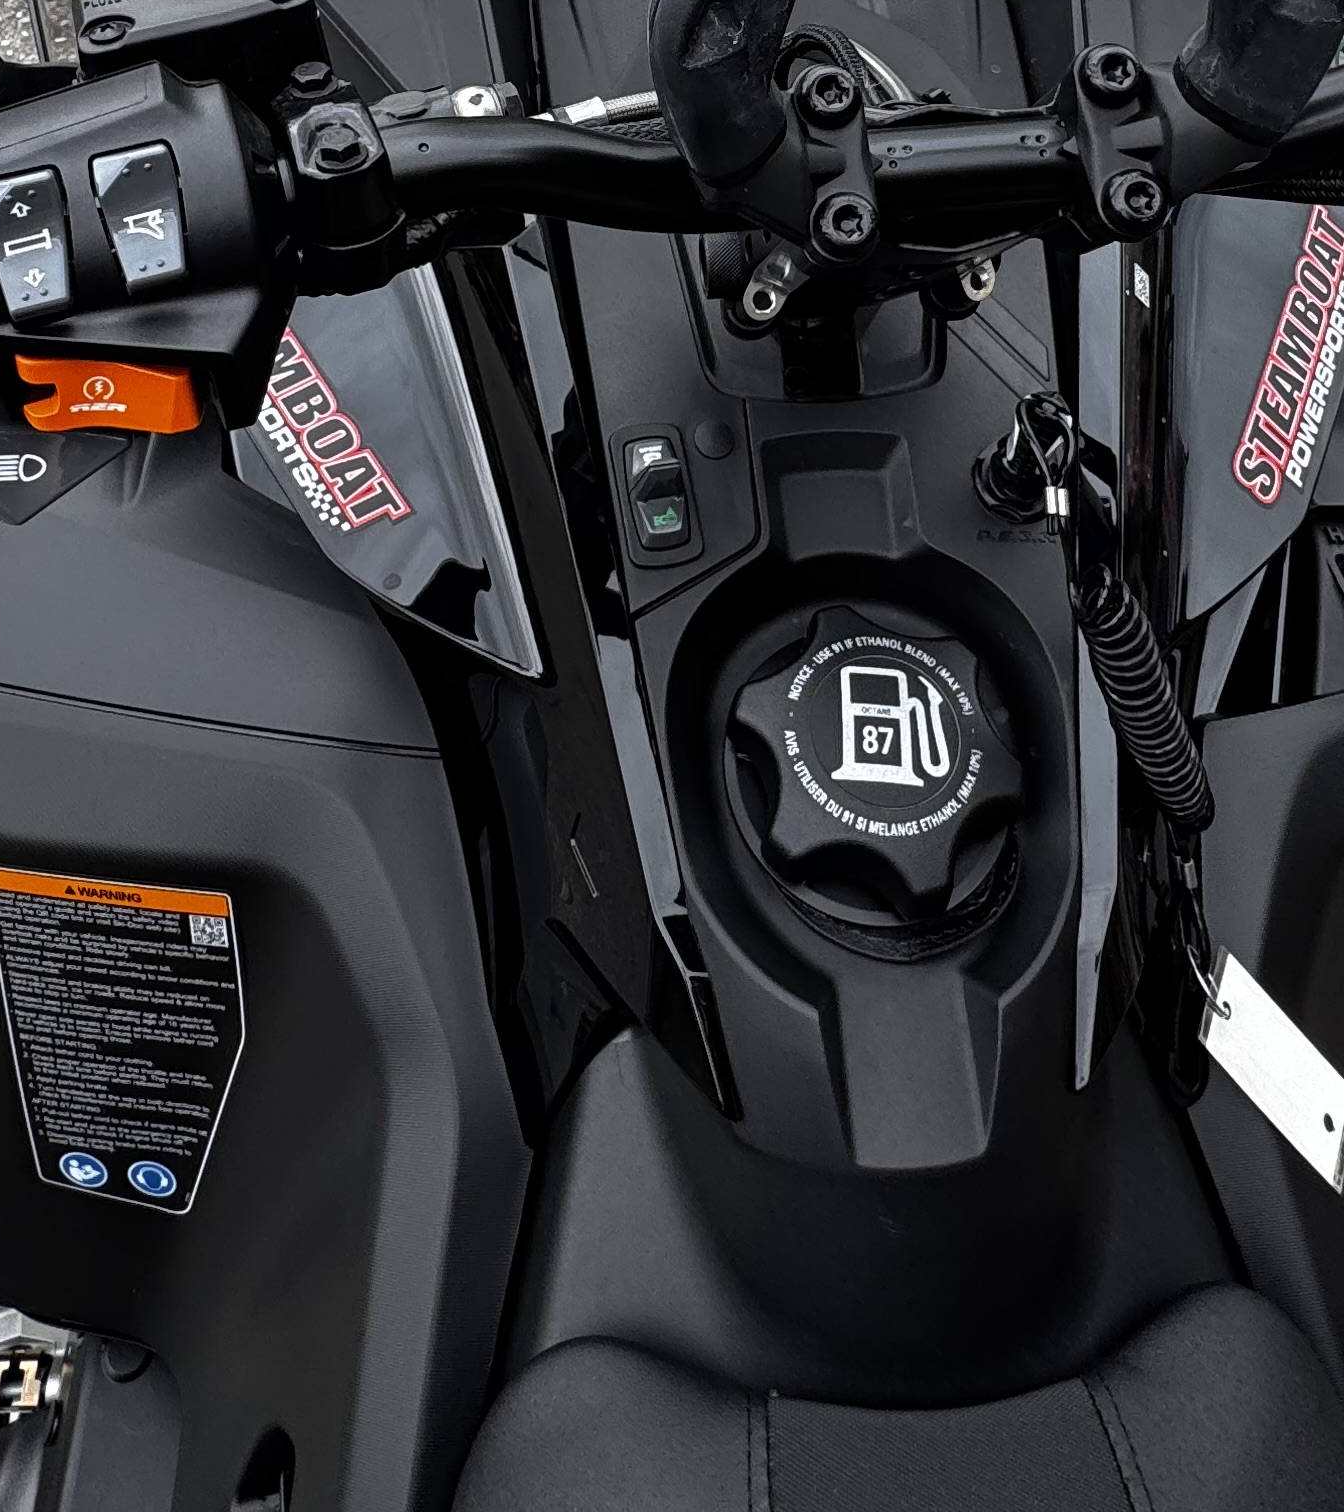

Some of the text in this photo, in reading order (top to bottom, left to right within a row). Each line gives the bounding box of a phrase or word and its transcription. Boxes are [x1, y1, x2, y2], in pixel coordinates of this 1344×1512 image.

[267, 329, 411, 528] MBOAT
[788, 637, 974, 716] NOTICE USE 91 IF ETHANOL BLEND (MAX 10%)
[861, 706, 892, 716] OCTANE
[862, 726, 894, 754] 87
[784, 730, 800, 756] AVIS
[793, 760, 828, 806] UTILISER
[824, 800, 844, 818] DU
[842, 810, 855, 825] 91
[856, 816, 867, 830] SI
[868, 820, 920, 837] MELANGE
[919, 798, 962, 832] ETHANOL
[957, 774, 978, 804] (MAX
[968, 749, 984, 775] 10%)
[78, 885, 142, 904] WARNING
